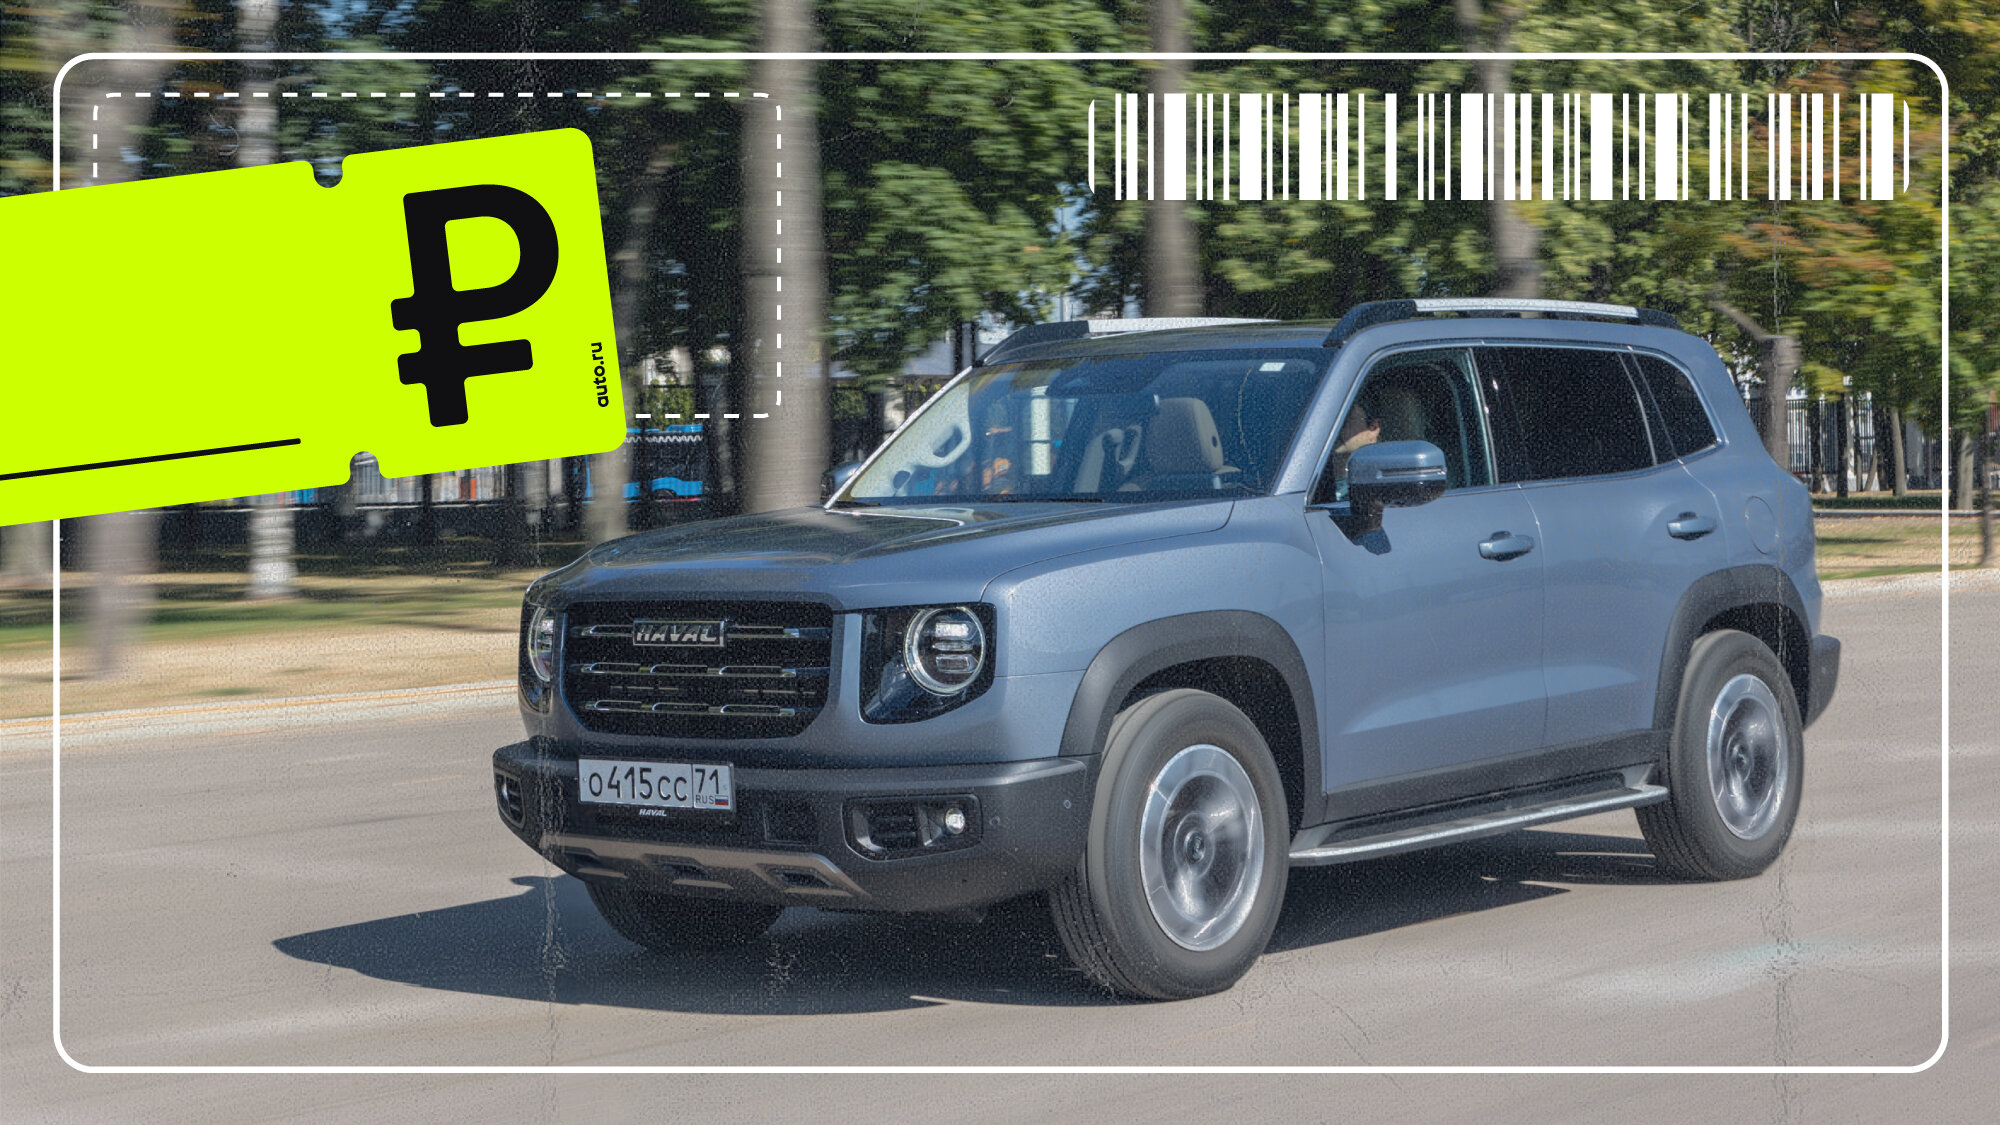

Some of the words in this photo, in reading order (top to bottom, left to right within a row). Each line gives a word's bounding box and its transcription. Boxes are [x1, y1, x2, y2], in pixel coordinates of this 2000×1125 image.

[636, 624, 717, 642] HAVAL
[694, 768, 720, 795] 71
[695, 794, 715, 805] RUS
[638, 808, 668, 817] HAVAL
